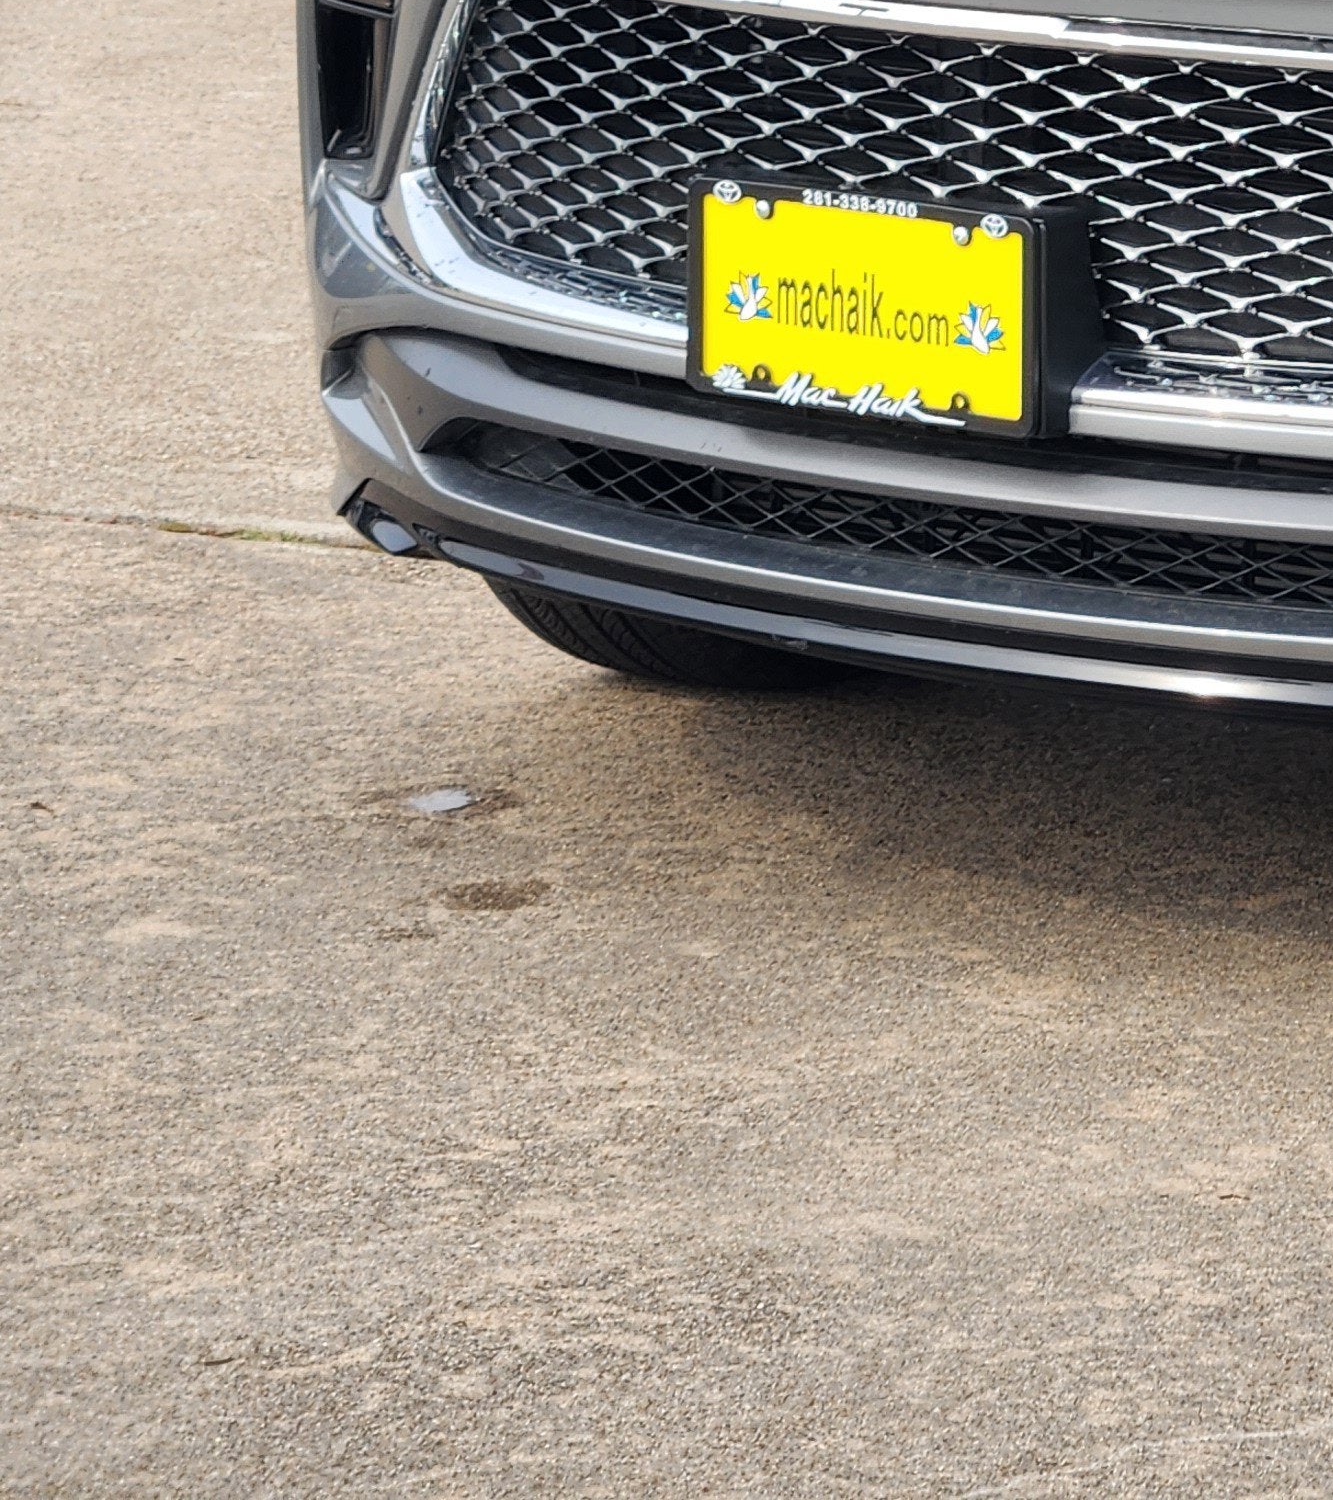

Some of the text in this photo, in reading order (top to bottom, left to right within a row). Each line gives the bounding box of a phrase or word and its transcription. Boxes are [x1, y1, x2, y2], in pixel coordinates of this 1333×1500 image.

[776, 268, 951, 348] machaik.com
[773, 371, 940, 421] Mac Haik
